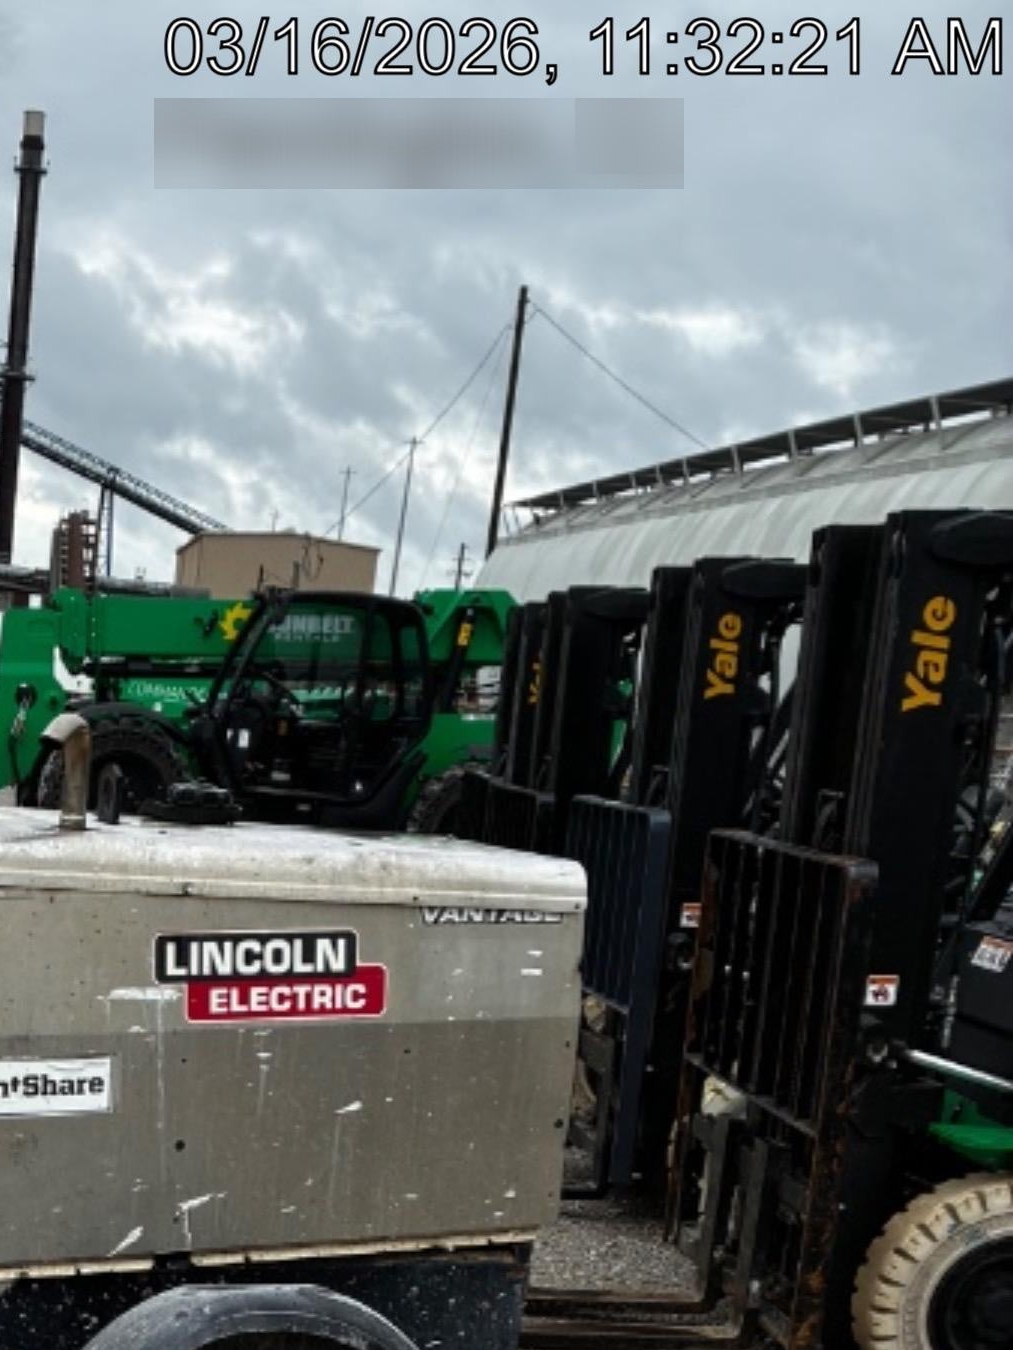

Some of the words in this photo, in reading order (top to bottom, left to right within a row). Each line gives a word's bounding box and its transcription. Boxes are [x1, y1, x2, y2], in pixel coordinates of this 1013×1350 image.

[704, 613, 742, 700] Yale
[902, 596, 956, 712] Yale
[165, 938, 348, 976] LINCOLN
[208, 983, 367, 1015] ELECTRIC
